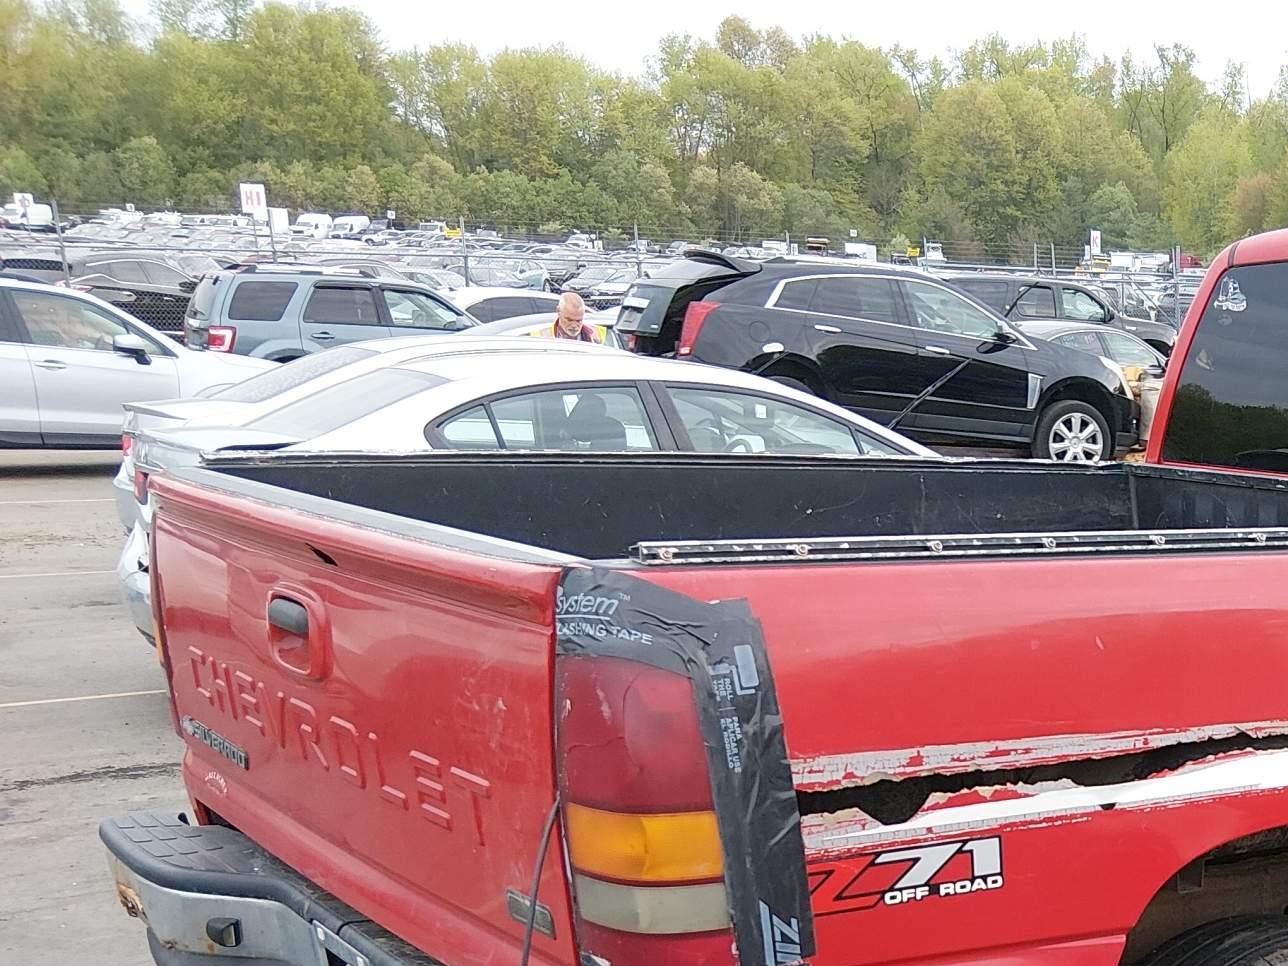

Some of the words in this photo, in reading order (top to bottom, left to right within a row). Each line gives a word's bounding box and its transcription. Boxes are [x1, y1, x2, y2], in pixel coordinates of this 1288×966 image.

[608, 626, 655, 646] TAPE
[187, 644, 493, 848] CHEVROLET
[191, 721, 247, 771] SILVERADO
[806, 834, 1003, 919] Z71
[883, 886, 930, 906] OFF
[939, 875, 1004, 898] ROAD
